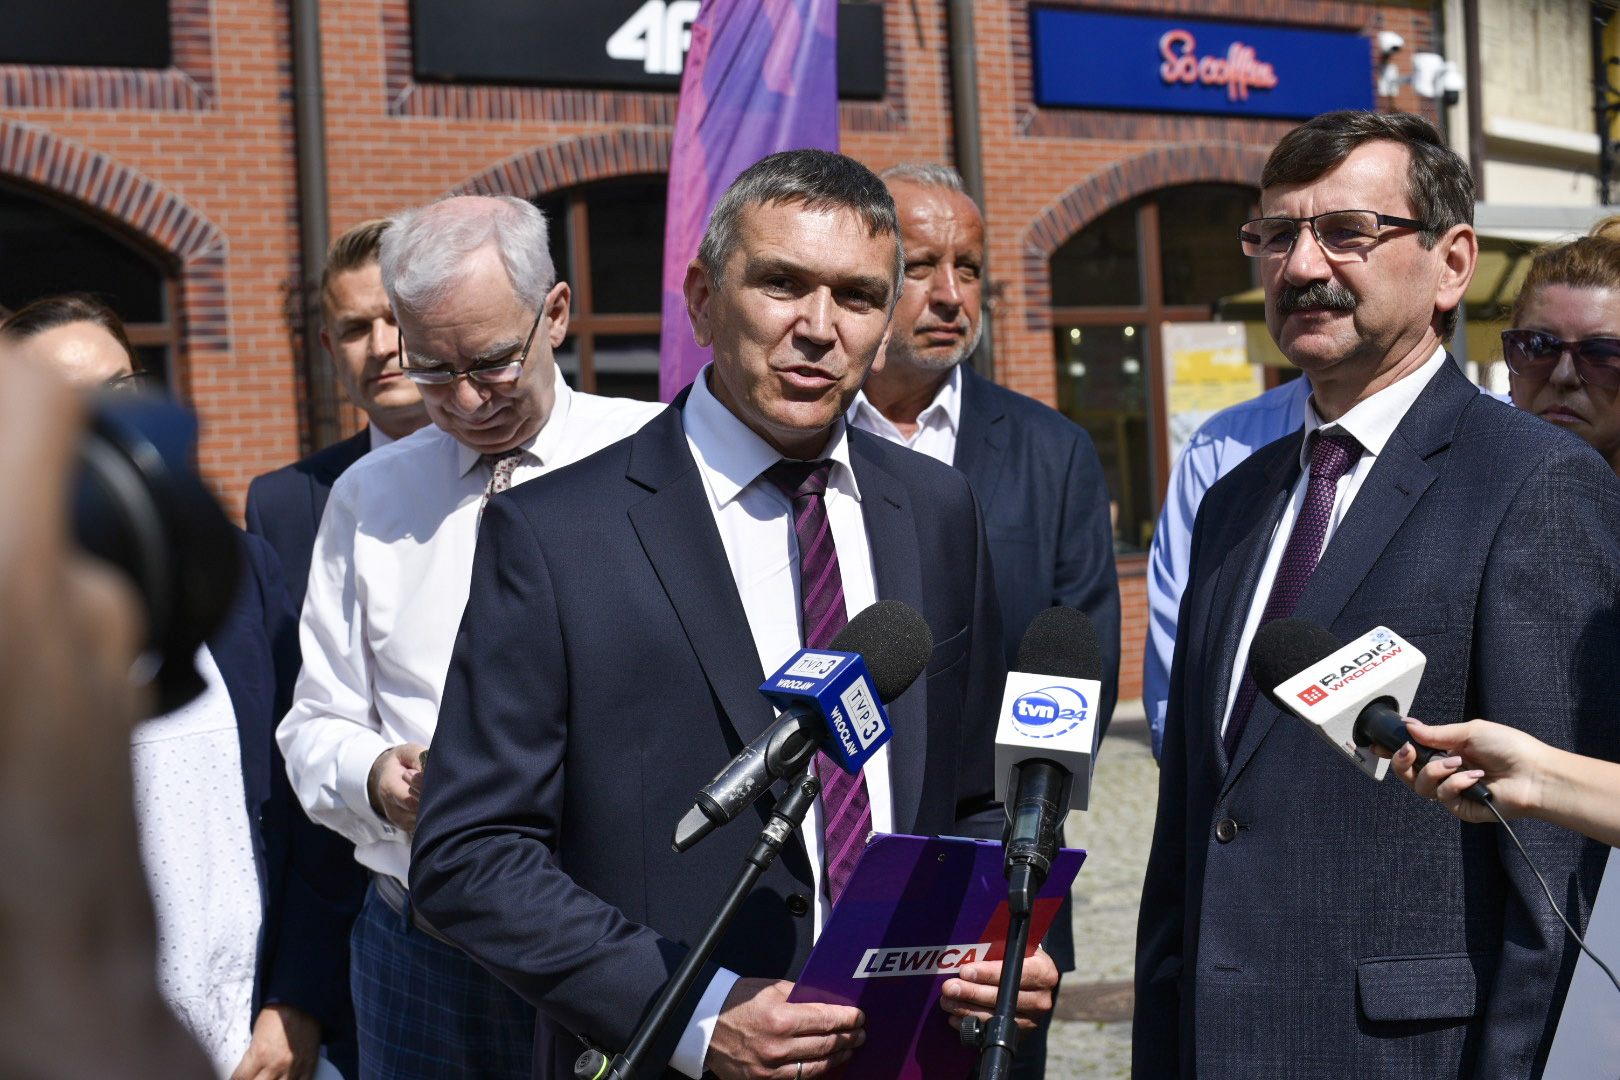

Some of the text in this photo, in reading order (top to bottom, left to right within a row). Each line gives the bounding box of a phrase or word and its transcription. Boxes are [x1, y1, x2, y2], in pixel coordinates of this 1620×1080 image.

[1319, 639, 1397, 686] RADIO
[1329, 646, 1402, 692] WROCŁAW
[864, 949, 977, 972] LEWICA
